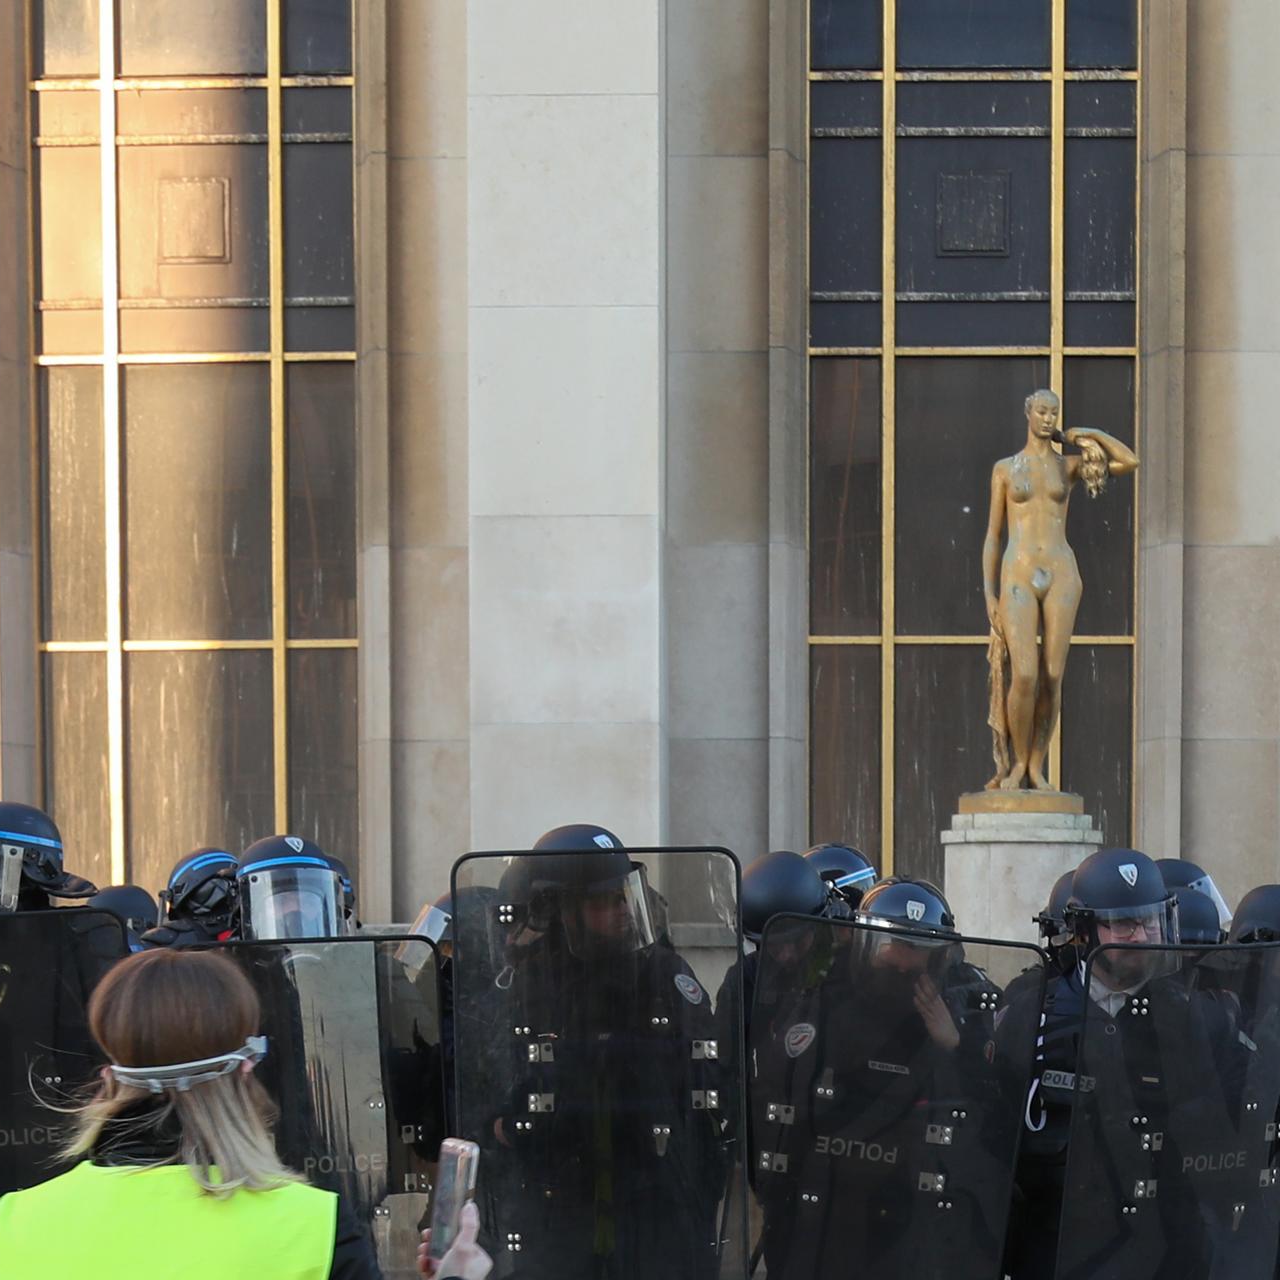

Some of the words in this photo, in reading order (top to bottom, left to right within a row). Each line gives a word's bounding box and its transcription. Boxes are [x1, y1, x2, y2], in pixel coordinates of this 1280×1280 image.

[815, 1135, 898, 1164] POLICE
[303, 1154, 384, 1175] POLICE
[1182, 1151, 1247, 1174] POLICE
